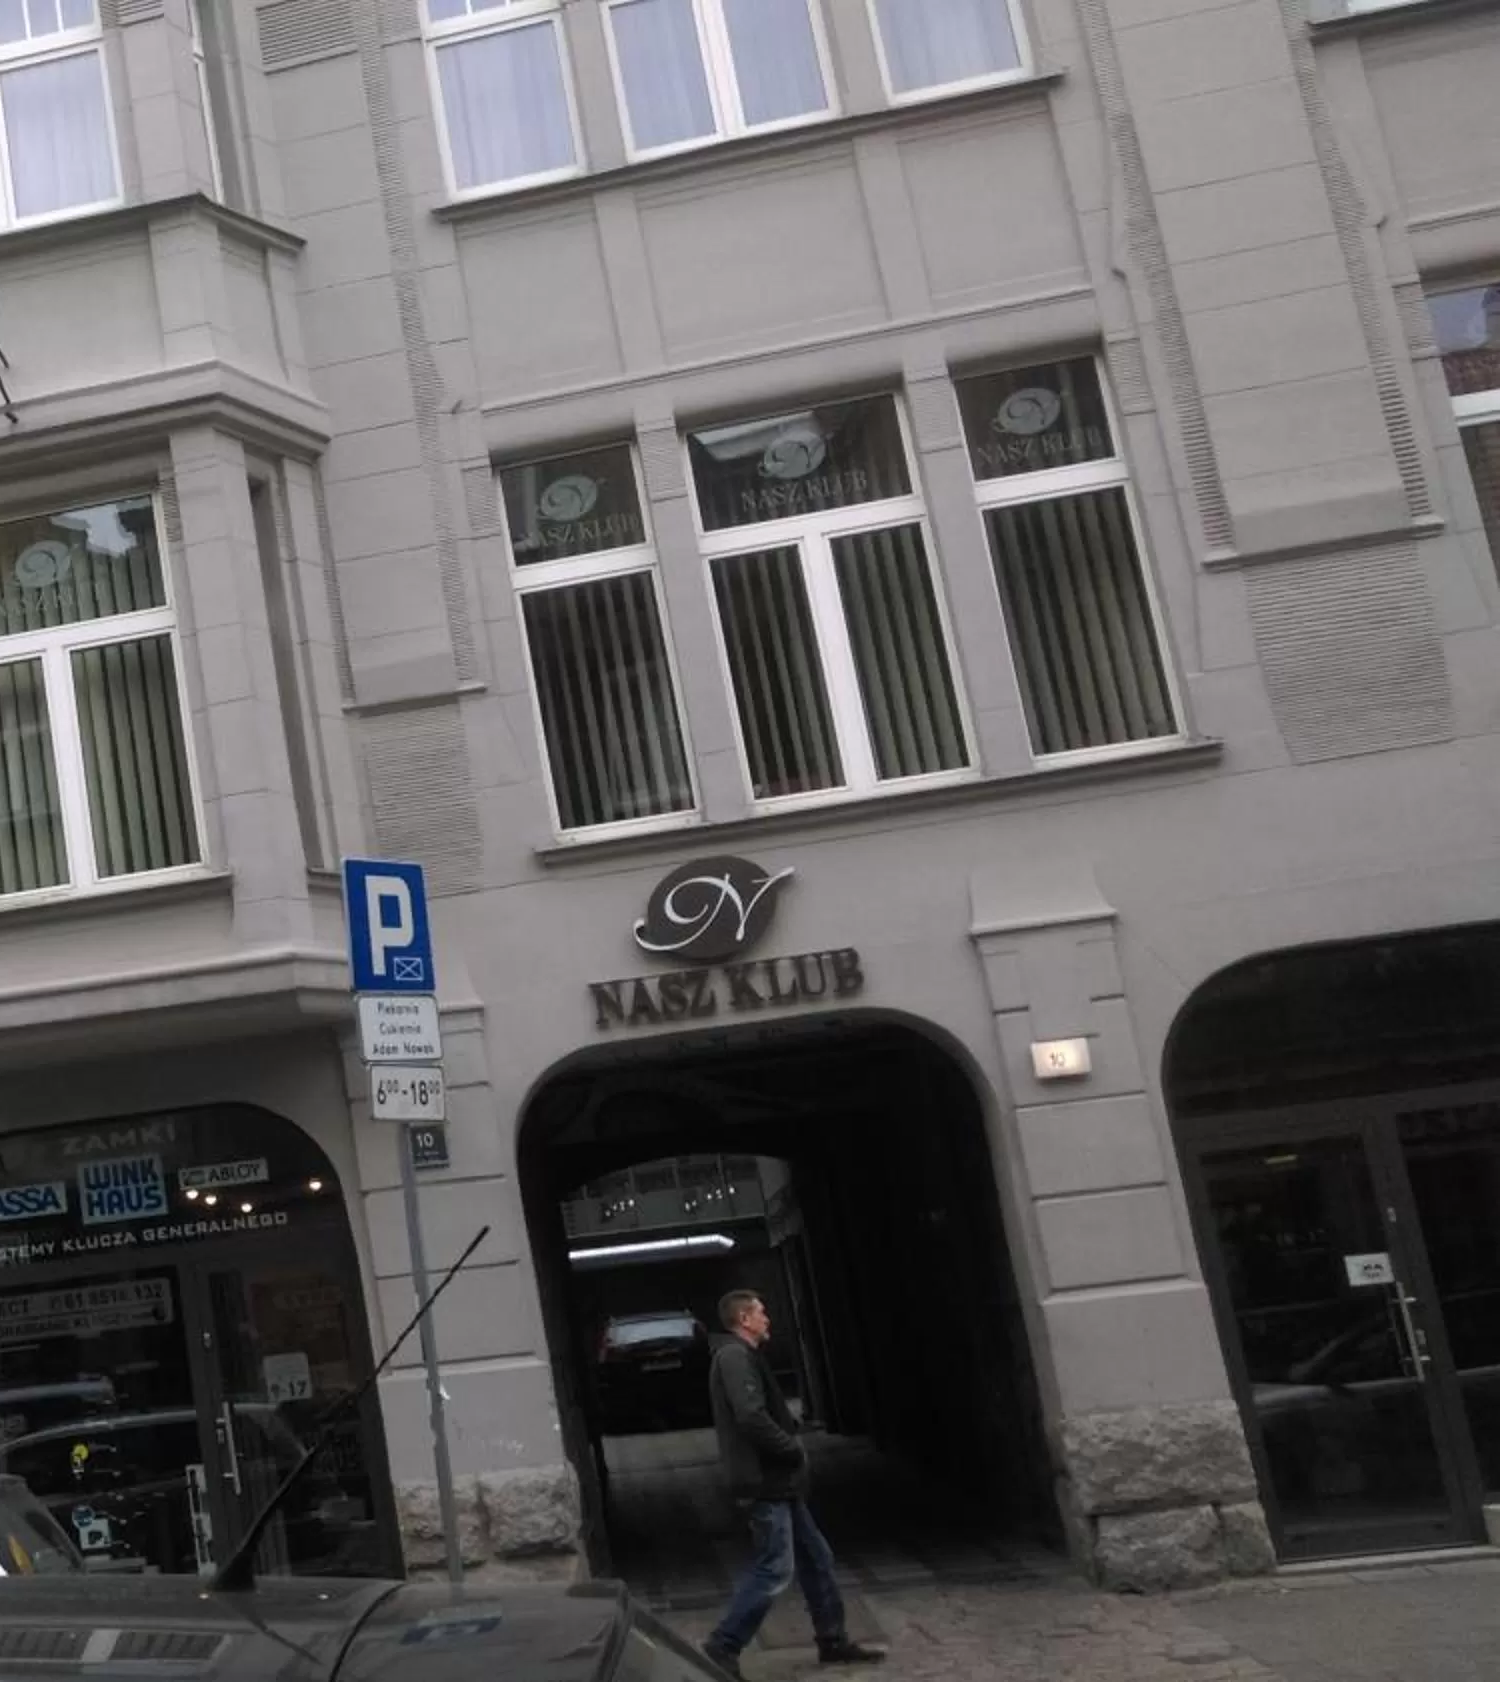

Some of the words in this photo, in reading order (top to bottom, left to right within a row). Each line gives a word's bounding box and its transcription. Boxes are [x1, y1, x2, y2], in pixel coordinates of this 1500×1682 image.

[364, 875, 415, 976] P
[588, 966, 717, 1032] NASZ
[726, 948, 864, 1009] KLUB
[61, 1122, 176, 1155] ZAMKI
[415, 1131, 434, 1148] 10
[83, 1158, 159, 1191] WINK
[208, 1163, 260, 1182] ABLOY
[86, 1184, 163, 1217] HAUS
[62, 1231, 138, 1253] KLUCZA
[142, 1211, 288, 1242] GENERALNEGO
